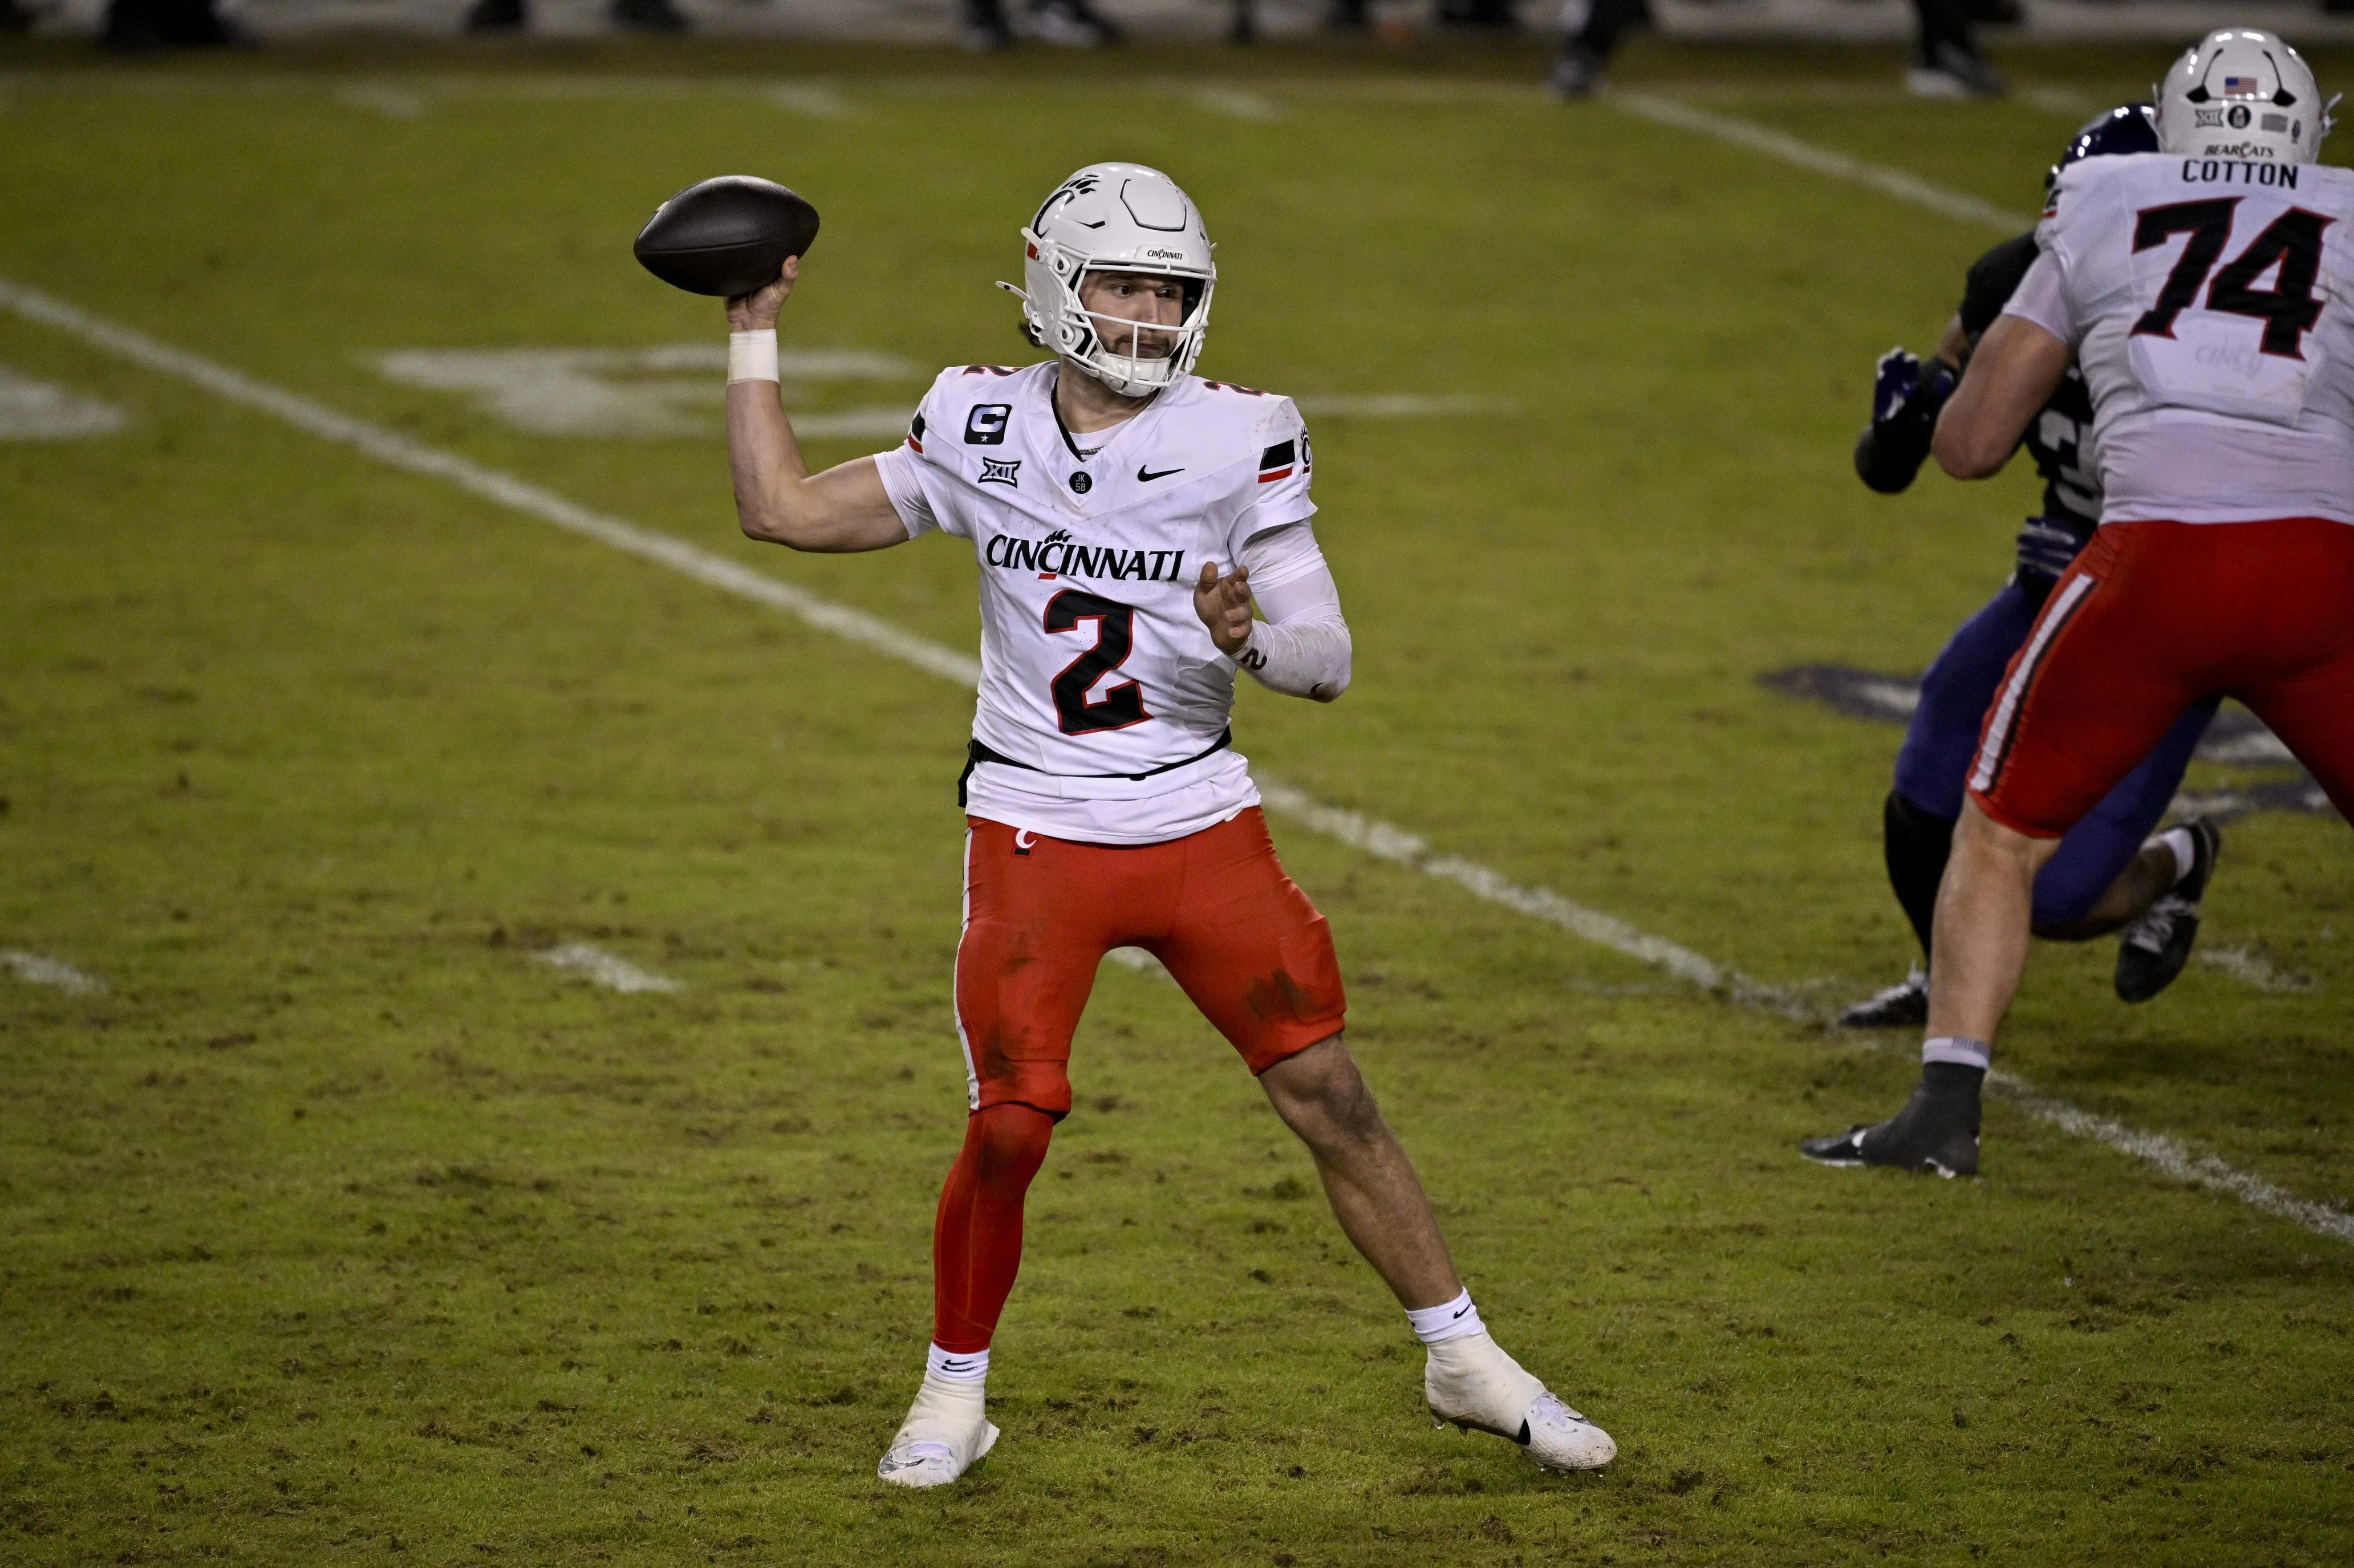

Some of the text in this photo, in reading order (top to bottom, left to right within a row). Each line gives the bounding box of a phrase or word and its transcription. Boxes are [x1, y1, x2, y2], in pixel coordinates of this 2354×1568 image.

[2182, 160, 2299, 190] COTTON
[1147, 249, 1183, 260] CINCINNATI
[2129, 196, 2339, 362] 74
[971, 406, 1007, 433] C
[1075, 474, 1086, 482] JK
[1075, 483, 1086, 491] 58
[986, 530, 1184, 582] CINCINNATI
[1042, 589, 1154, 736] 2
